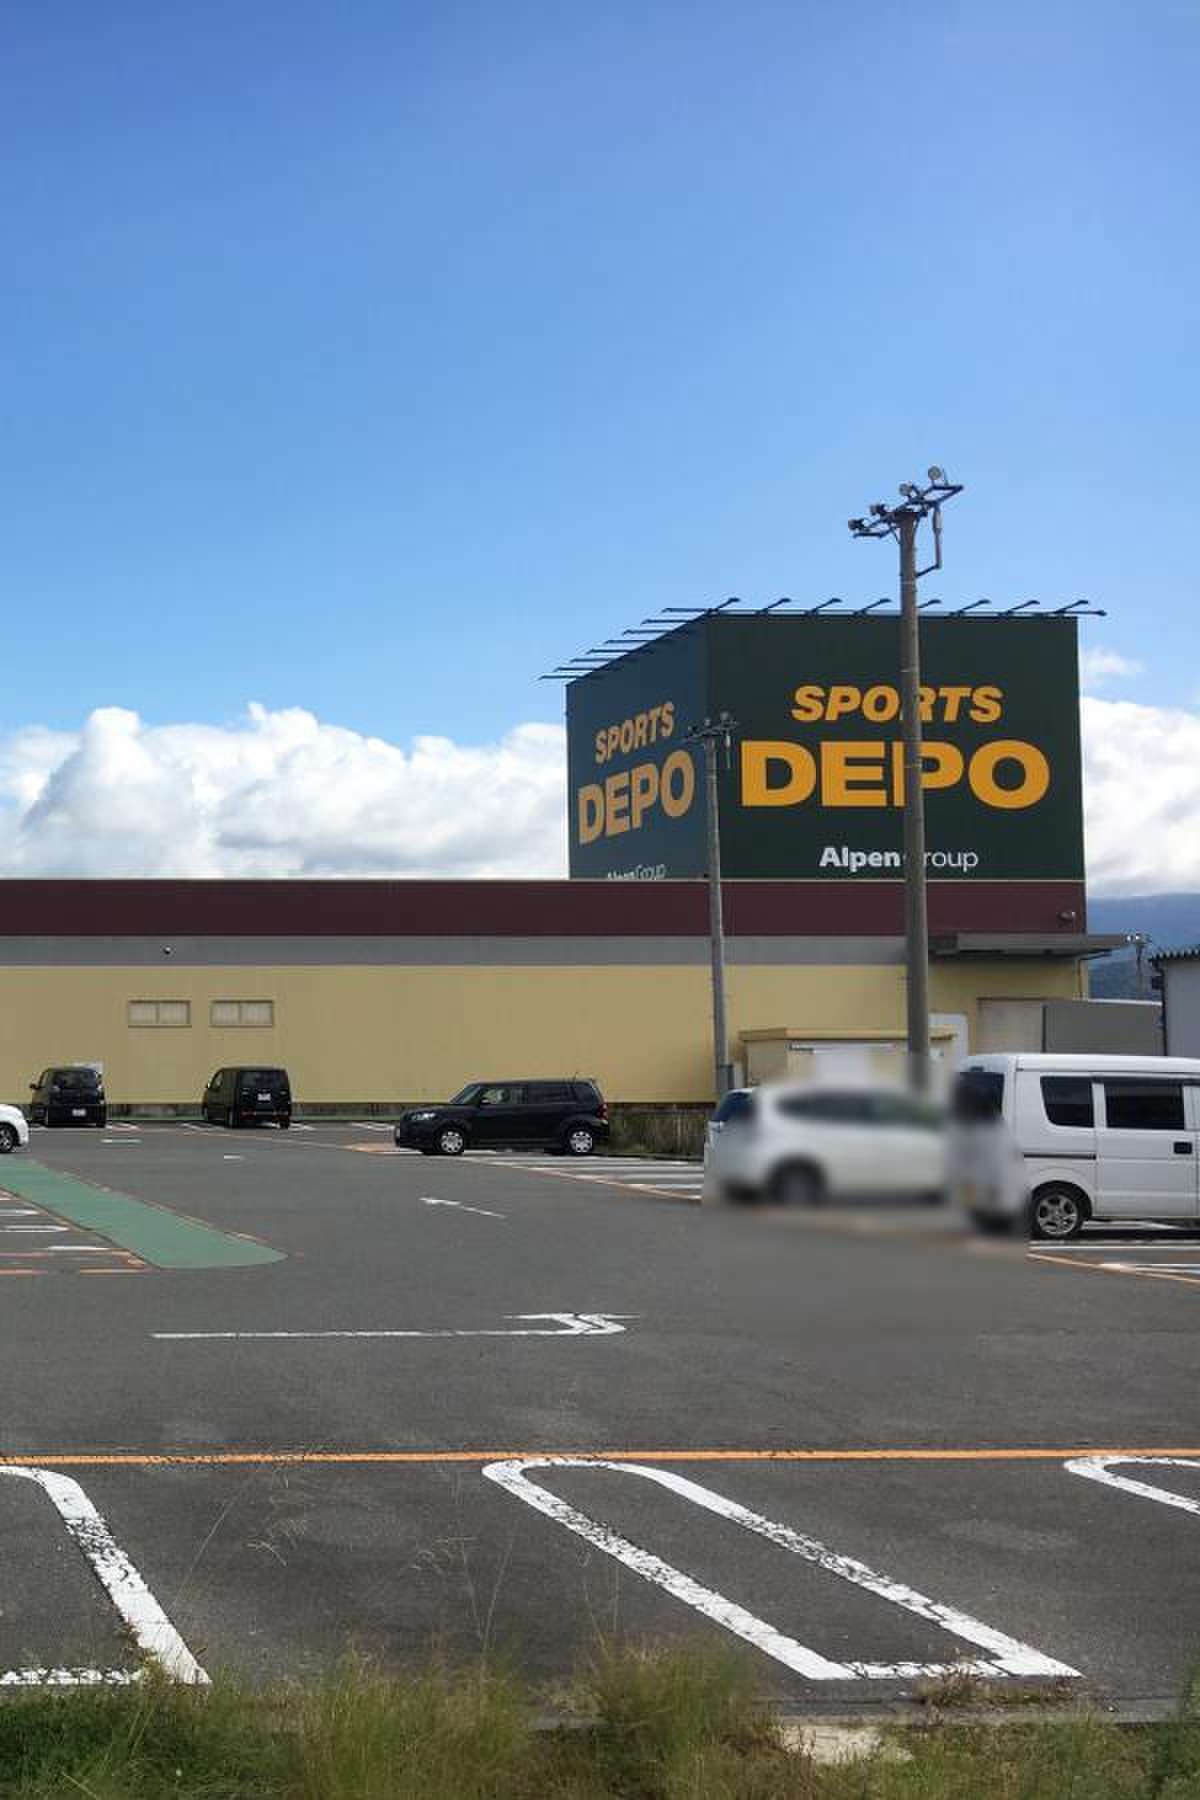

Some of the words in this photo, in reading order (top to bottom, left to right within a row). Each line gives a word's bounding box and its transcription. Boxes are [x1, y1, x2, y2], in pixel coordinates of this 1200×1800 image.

[594, 701, 674, 764] SPORTS
[791, 684, 1003, 723] SPORTS
[578, 749, 695, 845] DEPO
[740, 738, 1051, 810] DEPO
